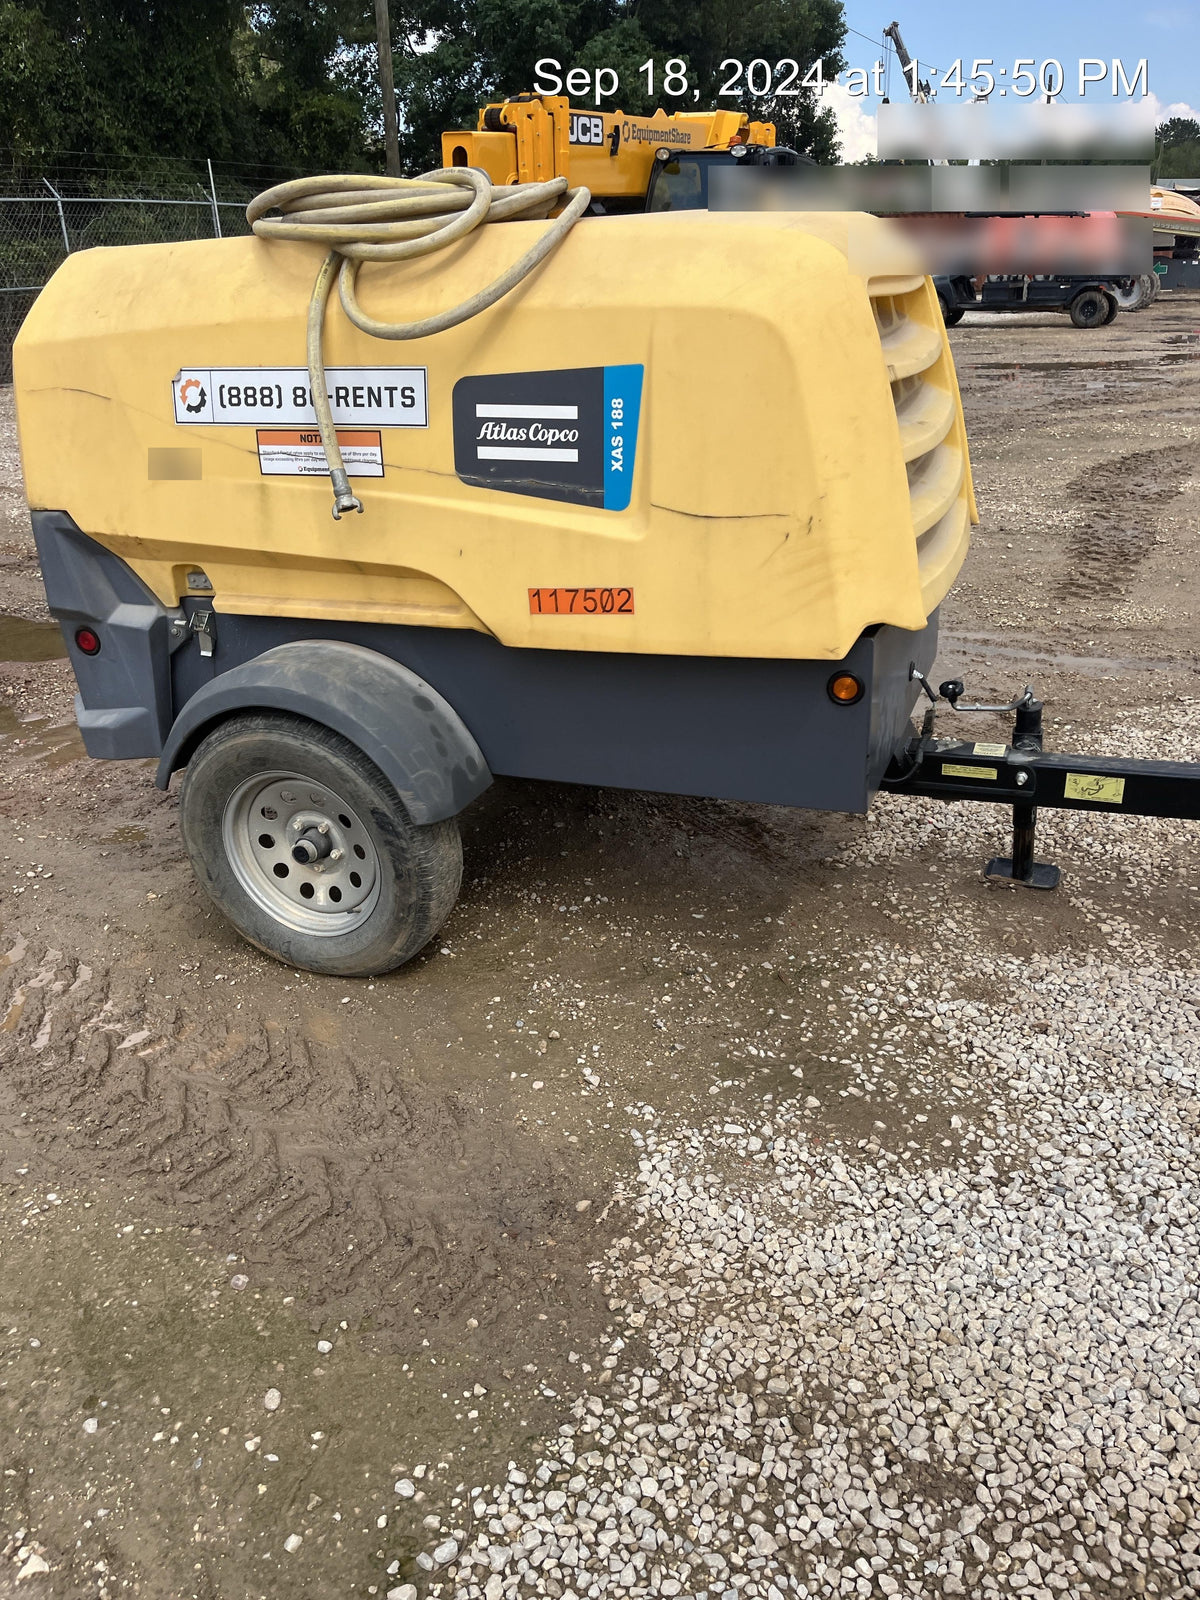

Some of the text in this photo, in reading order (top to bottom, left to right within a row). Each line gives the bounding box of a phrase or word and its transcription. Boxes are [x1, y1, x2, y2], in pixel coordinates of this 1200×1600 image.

[569, 116, 603, 144] JCB
[631, 123, 691, 145] EquipmentShare
[218, 384, 283, 409] (888)
[299, 434, 323, 443] NOTI
[476, 421, 579, 446] Atlas Copco
[610, 398, 624, 473] XAS 188
[531, 587, 633, 613] 117502
